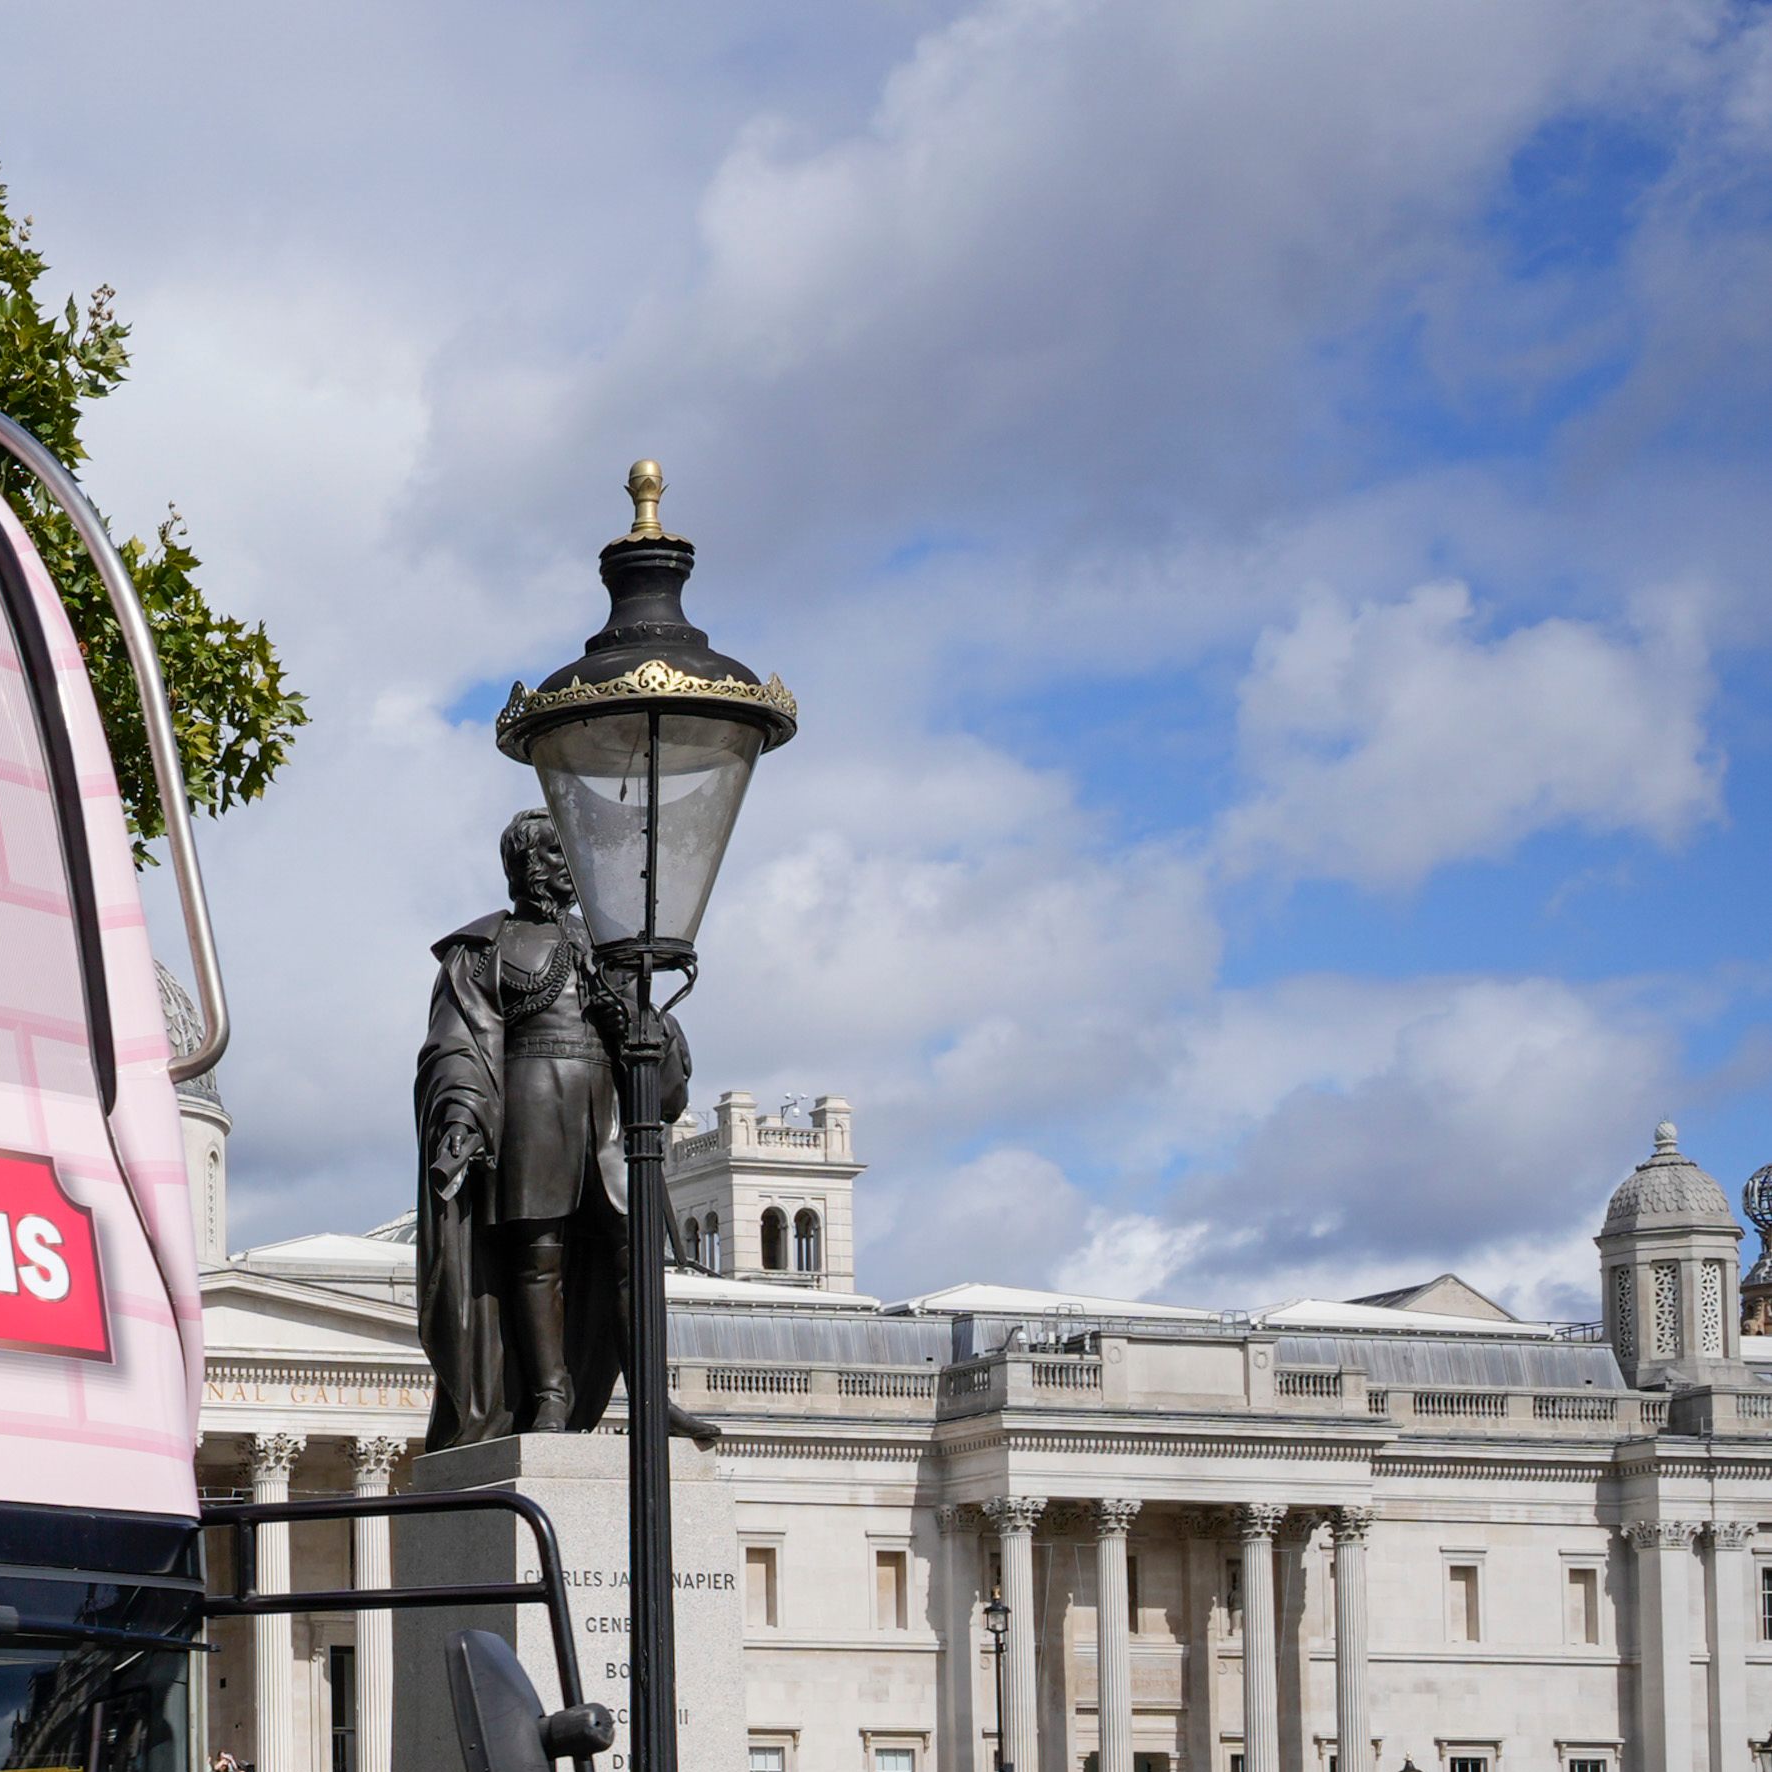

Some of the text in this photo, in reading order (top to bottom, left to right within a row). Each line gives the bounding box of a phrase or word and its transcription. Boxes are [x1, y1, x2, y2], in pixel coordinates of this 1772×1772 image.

[289, 1384, 434, 1409] GALLERY
[523, 1570, 603, 1588] CHRLES
[672, 1572, 736, 1590] NAPIER
[584, 1617, 631, 1634] GENE
